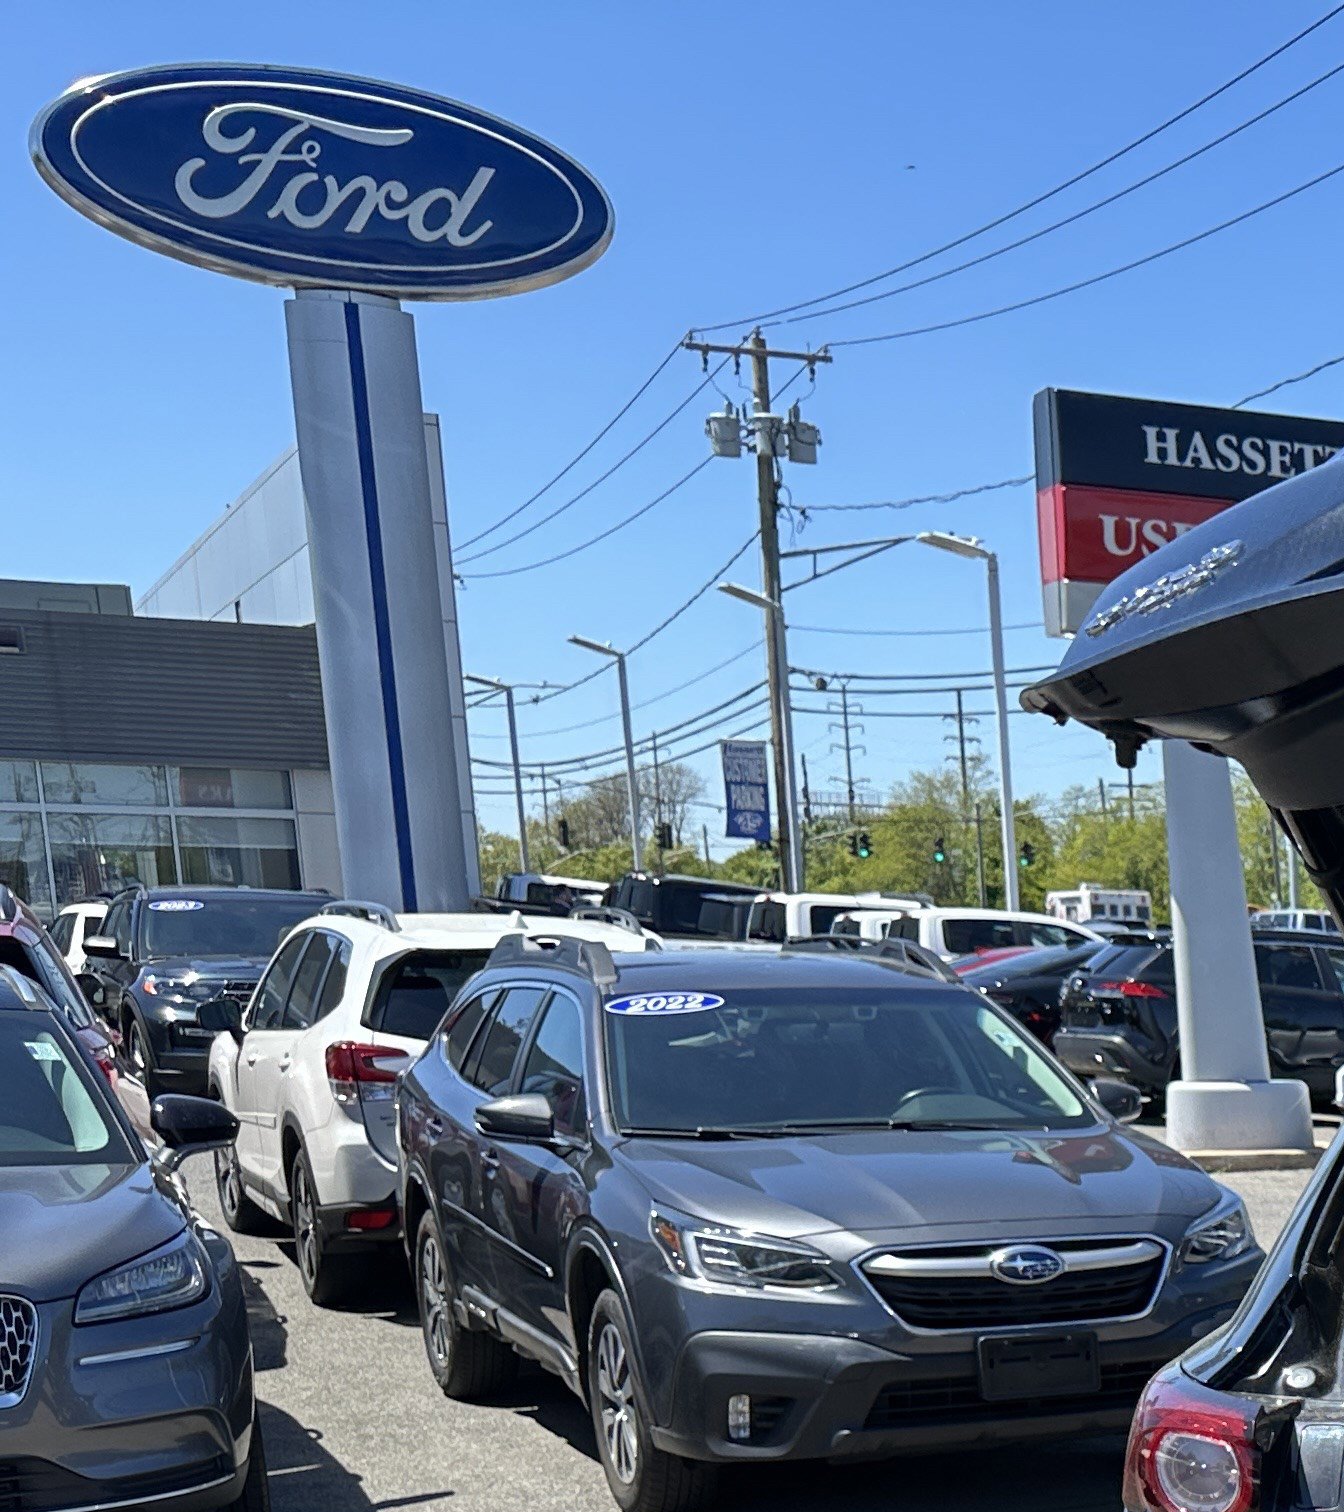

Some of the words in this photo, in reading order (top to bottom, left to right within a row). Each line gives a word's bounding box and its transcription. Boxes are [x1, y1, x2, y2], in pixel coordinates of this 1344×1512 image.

[174, 101, 496, 248] Ford
[1098, 514, 1200, 558] US
[625, 993, 705, 1014] 2022
